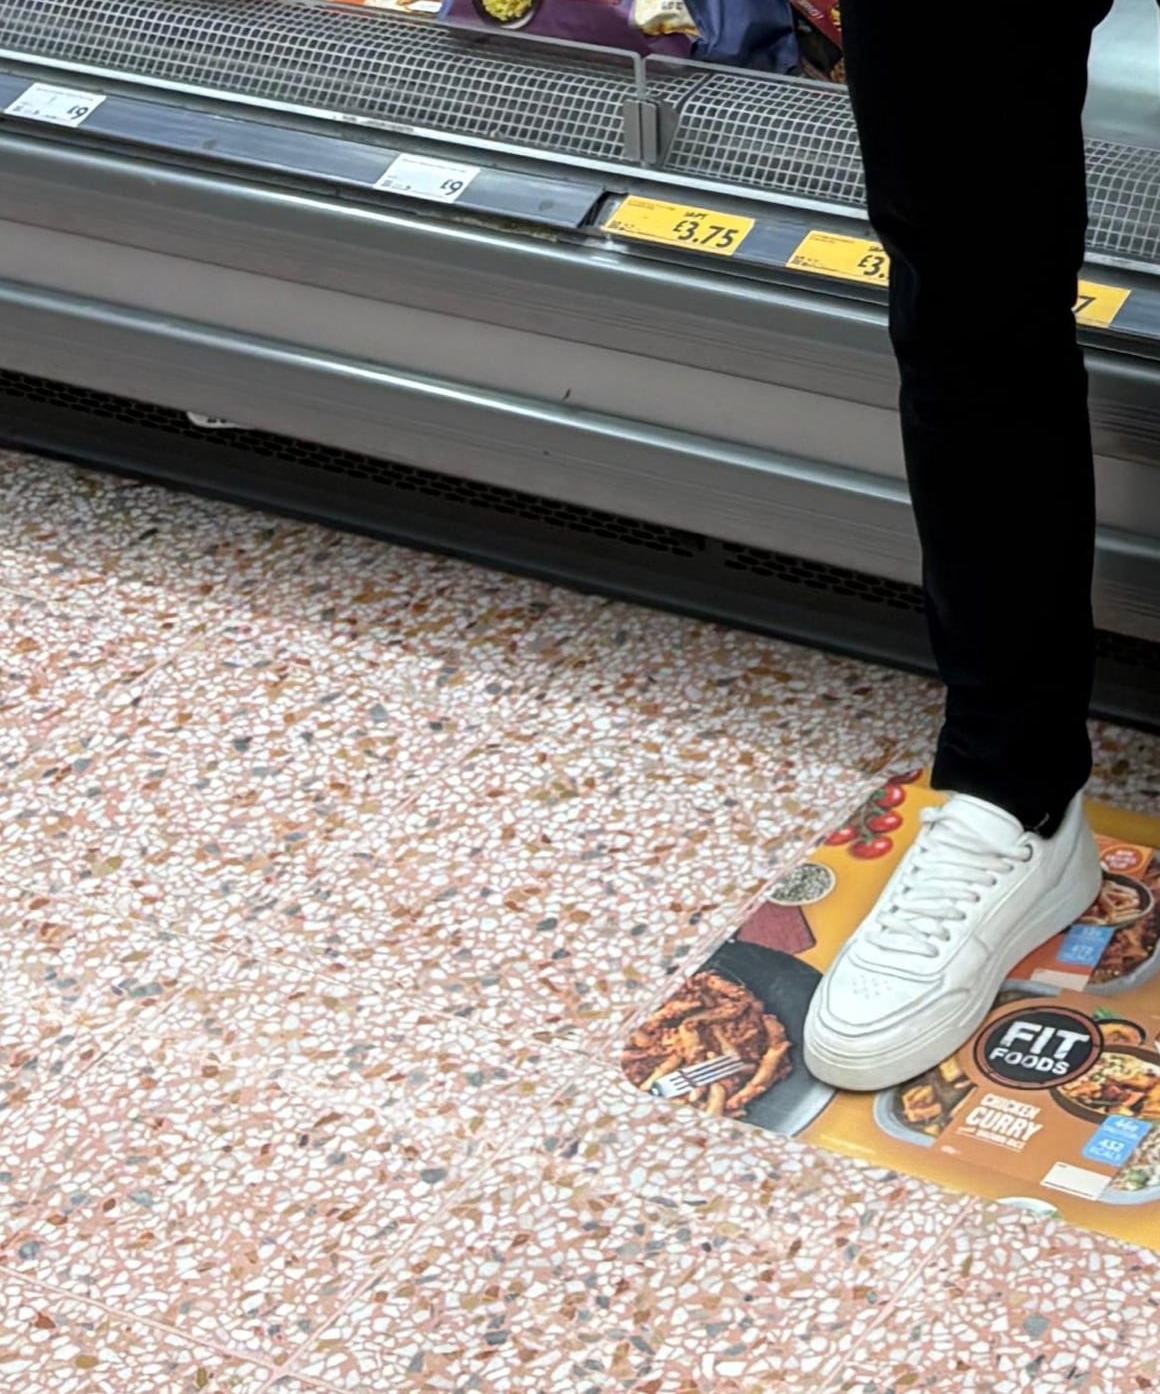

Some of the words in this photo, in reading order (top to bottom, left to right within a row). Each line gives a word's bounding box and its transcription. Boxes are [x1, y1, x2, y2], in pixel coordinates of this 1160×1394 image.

[440, 180, 464, 203] £9
[673, 219, 739, 248] £3.75
[1001, 1022, 1091, 1060] FIT
[990, 1049, 1070, 1075] FOODS
[979, 1092, 1041, 1119] CHICKEN
[965, 1108, 1044, 1142] CURRY
